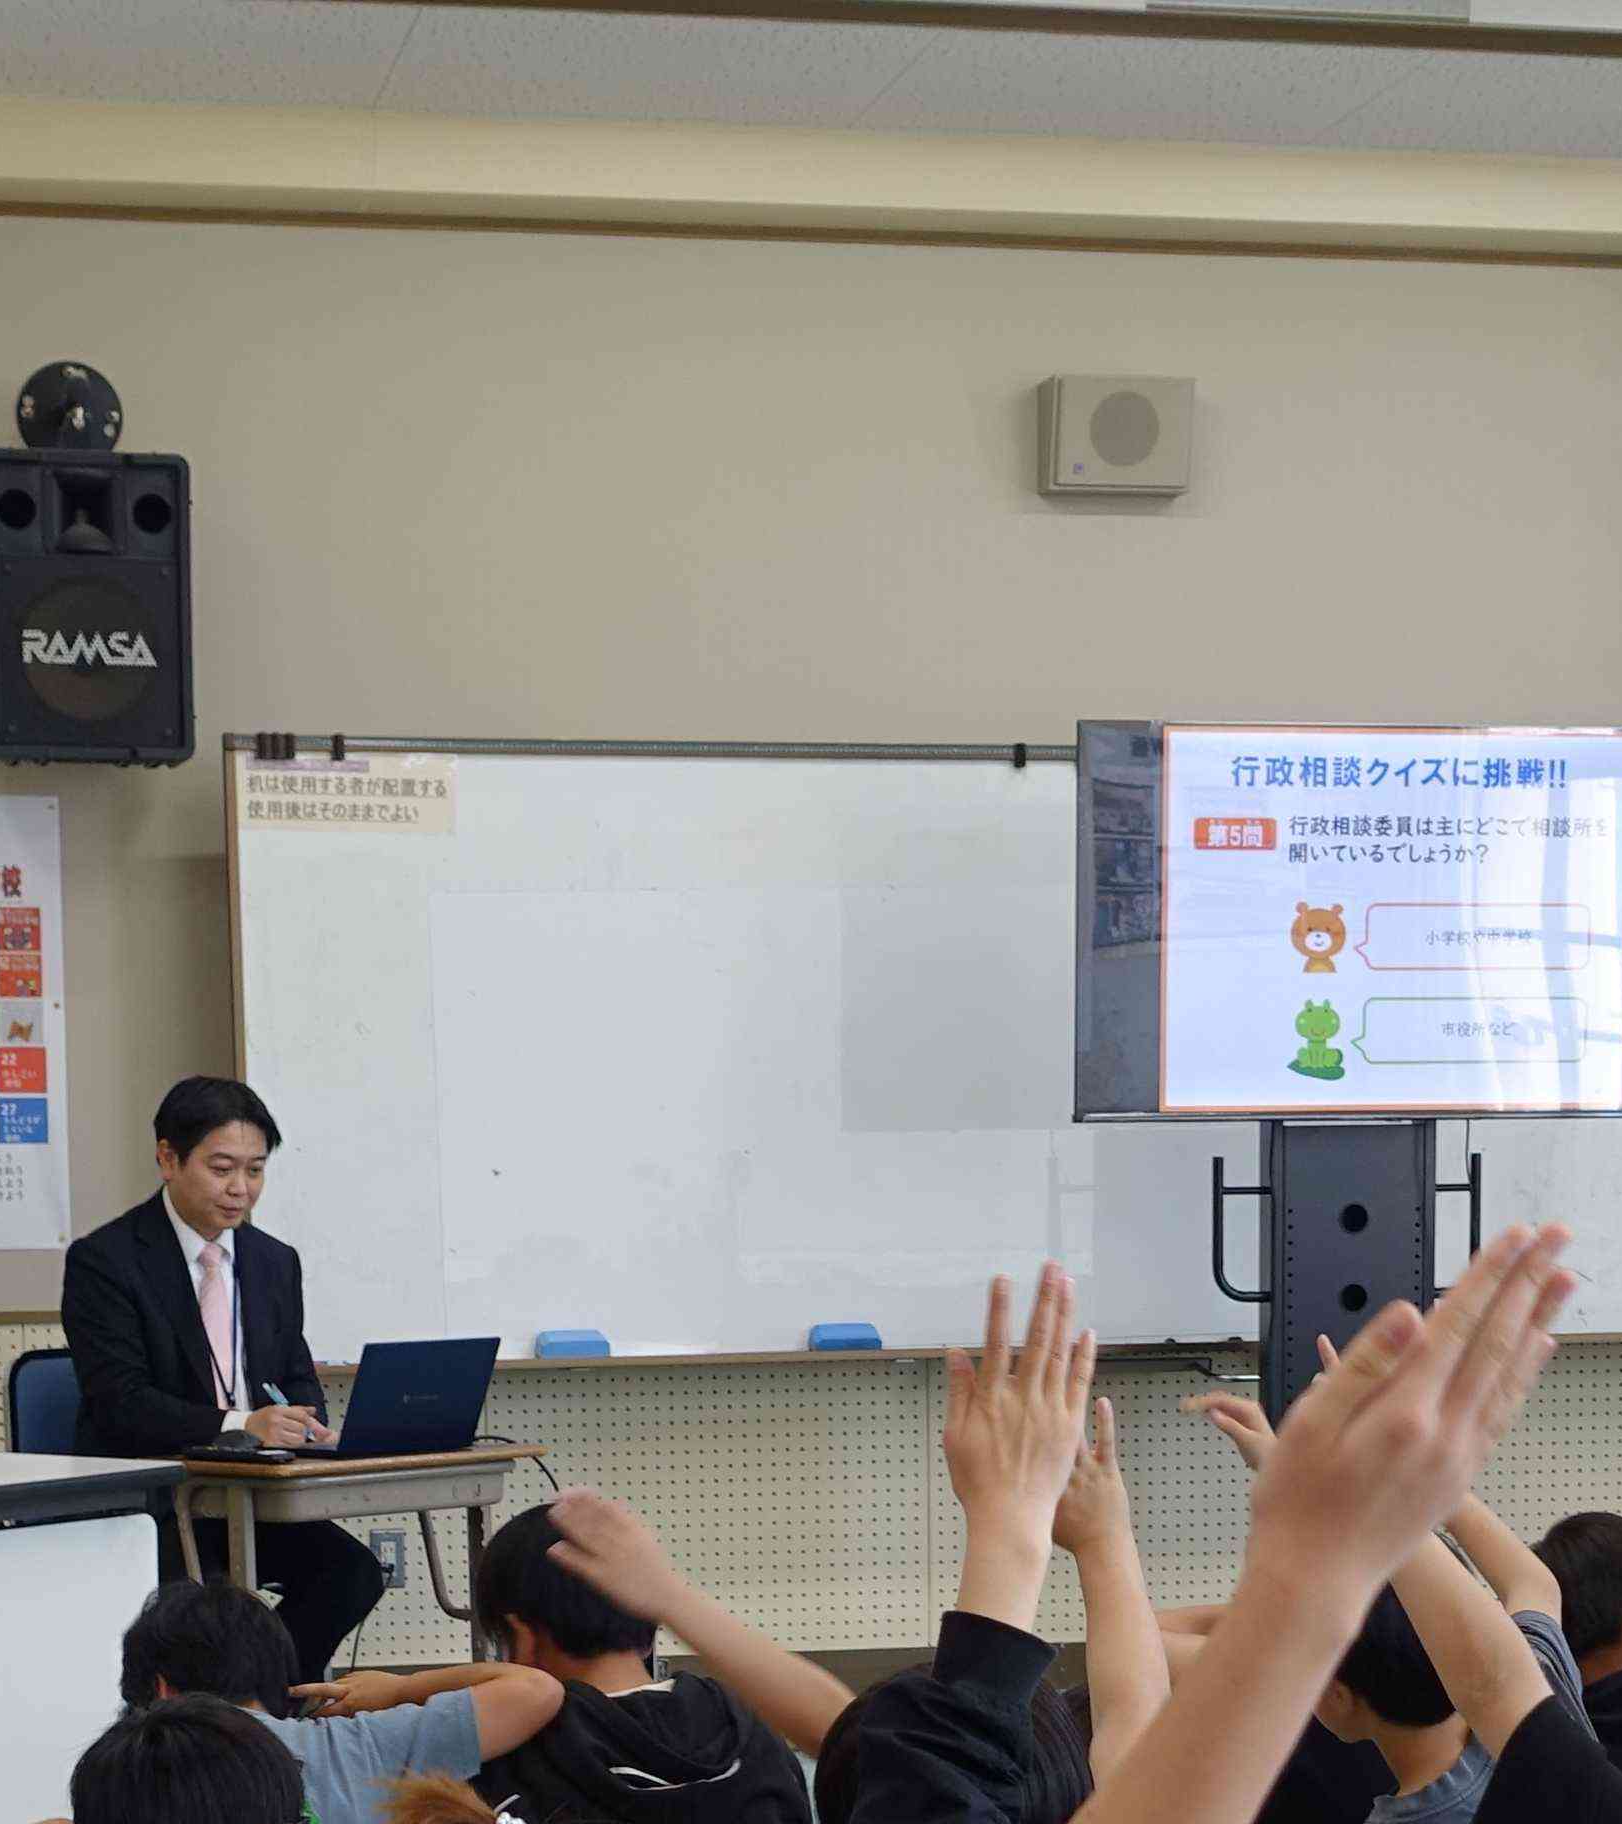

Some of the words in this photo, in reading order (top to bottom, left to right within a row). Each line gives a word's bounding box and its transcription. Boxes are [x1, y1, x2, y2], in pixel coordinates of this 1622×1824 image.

[21, 629, 157, 668] RAMSA
[246, 776, 447, 798] 机は使用する者が配置する
[247, 801, 419, 823] 使用後はそのままでよい
[1207, 821, 1265, 850] 第5問
